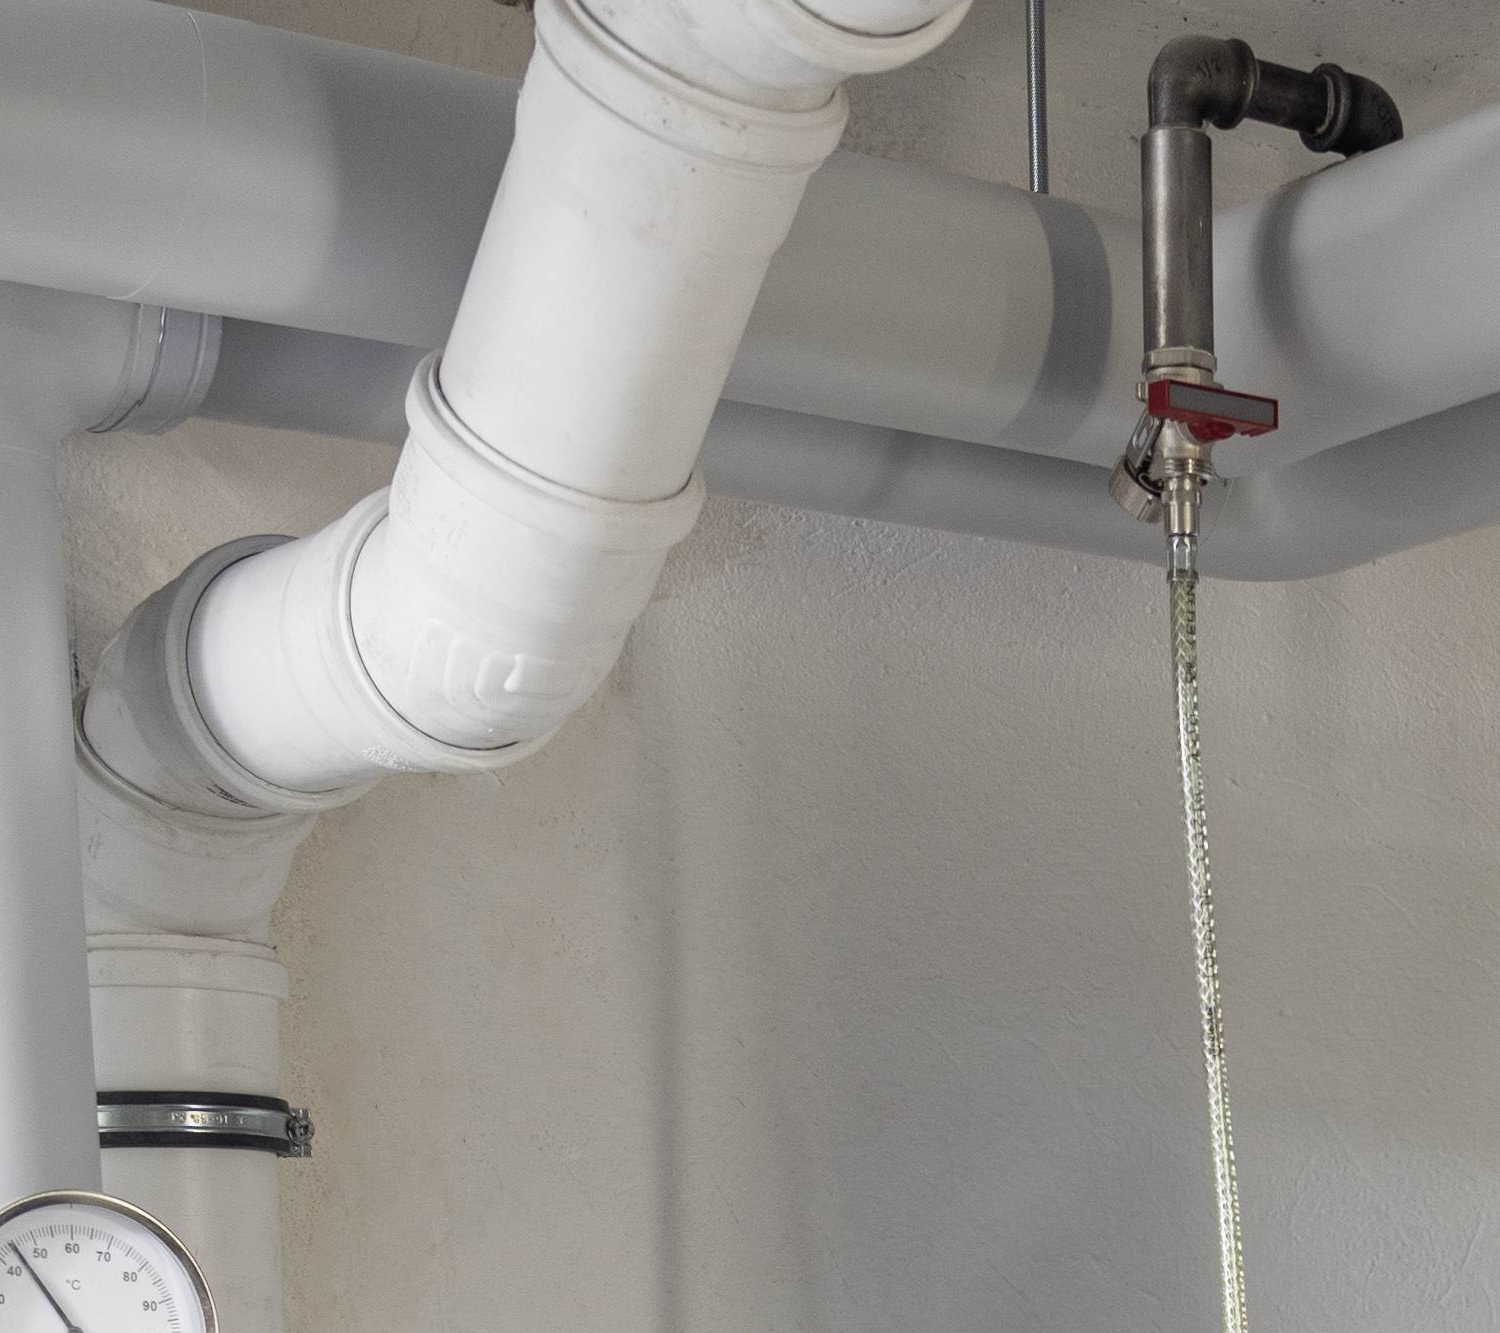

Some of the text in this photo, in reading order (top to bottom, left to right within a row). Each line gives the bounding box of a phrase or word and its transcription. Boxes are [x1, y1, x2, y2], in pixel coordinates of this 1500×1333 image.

[33, 1248, 48, 1259] 50
[65, 1243, 80, 1254] 60
[96, 1252, 111, 1262] 70
[7, 1266, 22, 1277] 40
[123, 1272, 138, 1282] 80
[66, 1279, 81, 1290] °C
[142, 1301, 157, 1312] 90
